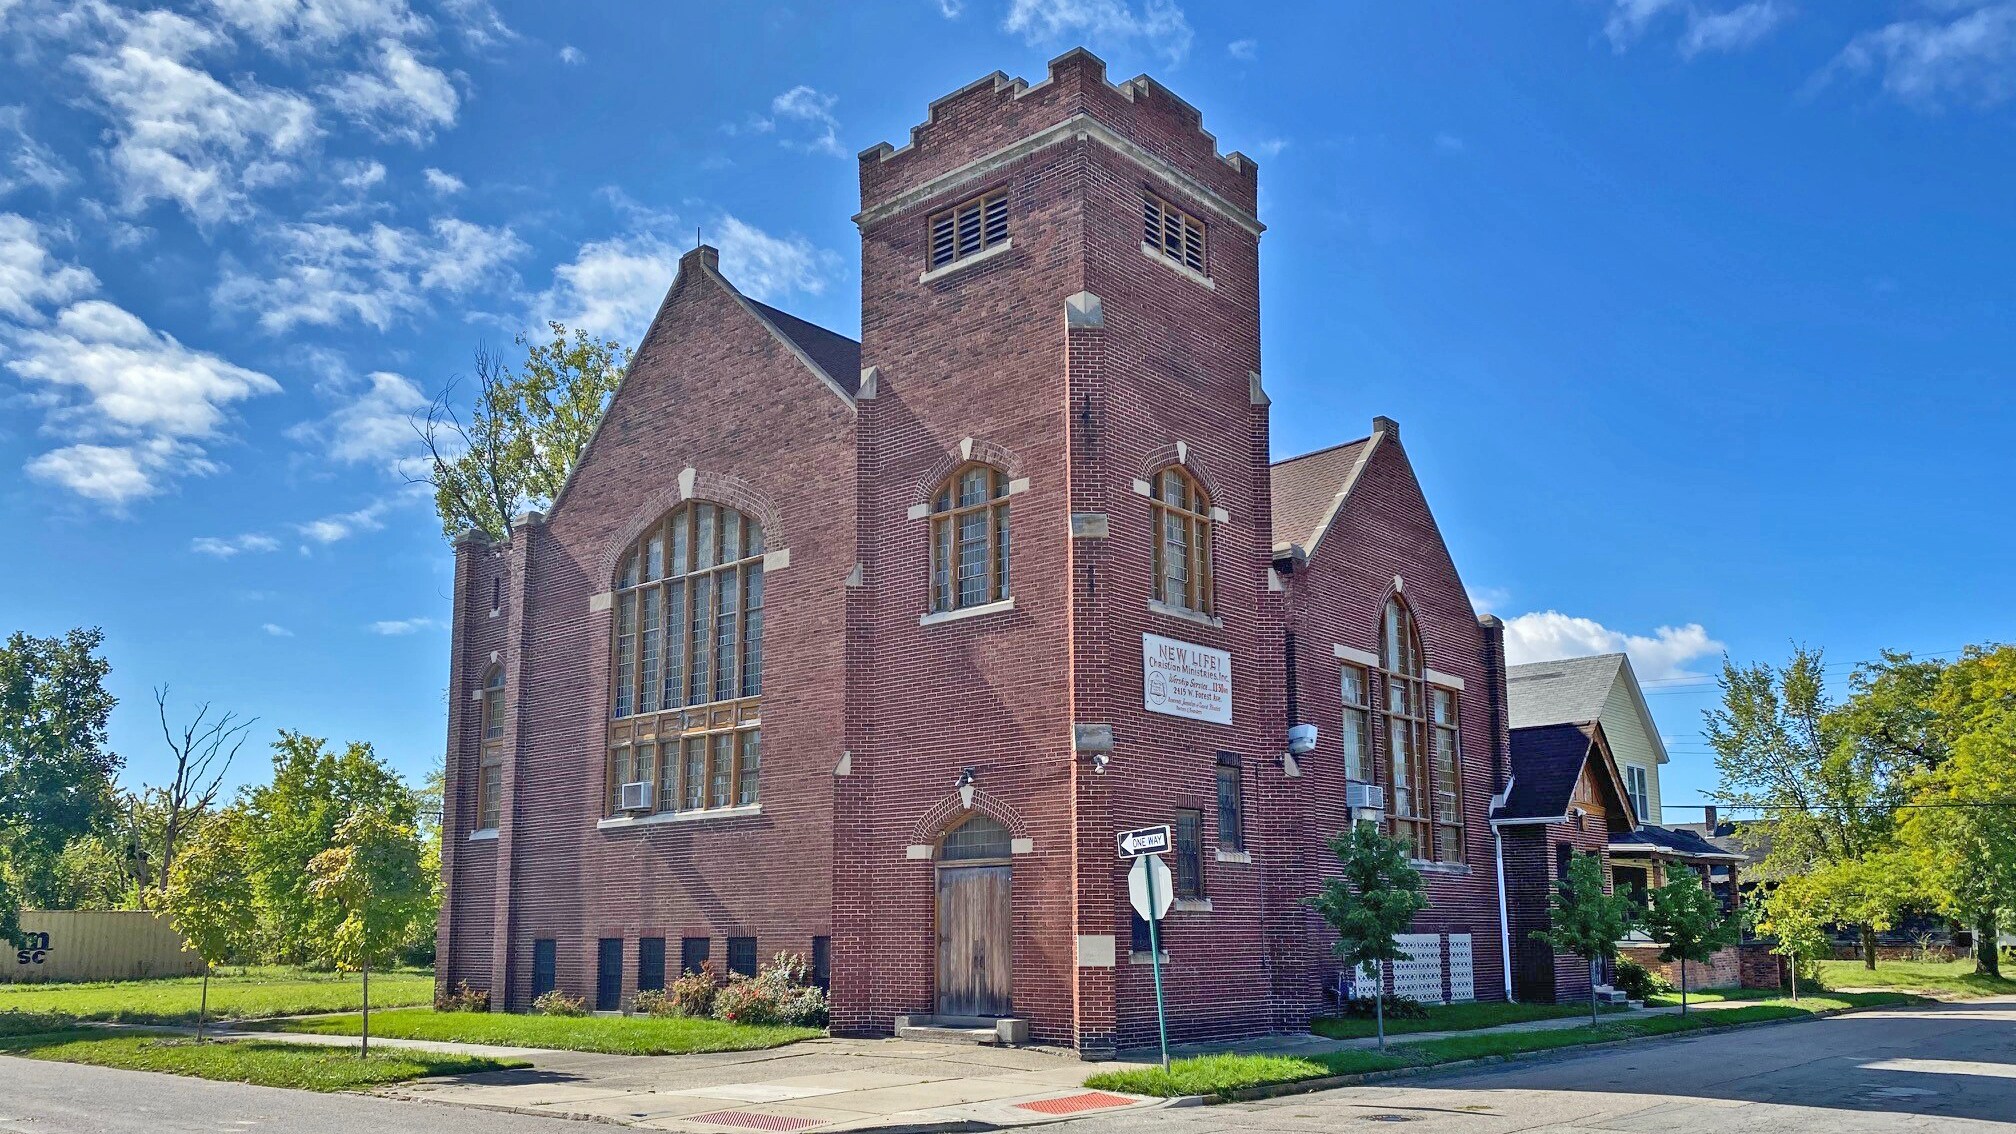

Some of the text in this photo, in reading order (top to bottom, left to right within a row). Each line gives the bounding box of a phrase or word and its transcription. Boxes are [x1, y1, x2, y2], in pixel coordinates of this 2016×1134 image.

[1149, 656, 1181, 672] Christian
[1159, 644, 1221, 671] NEW LIFE!
[1169, 673, 1190, 688] Worship
[1195, 690, 1212, 701] Forest
[1132, 835, 1162, 848] ONE WAY
